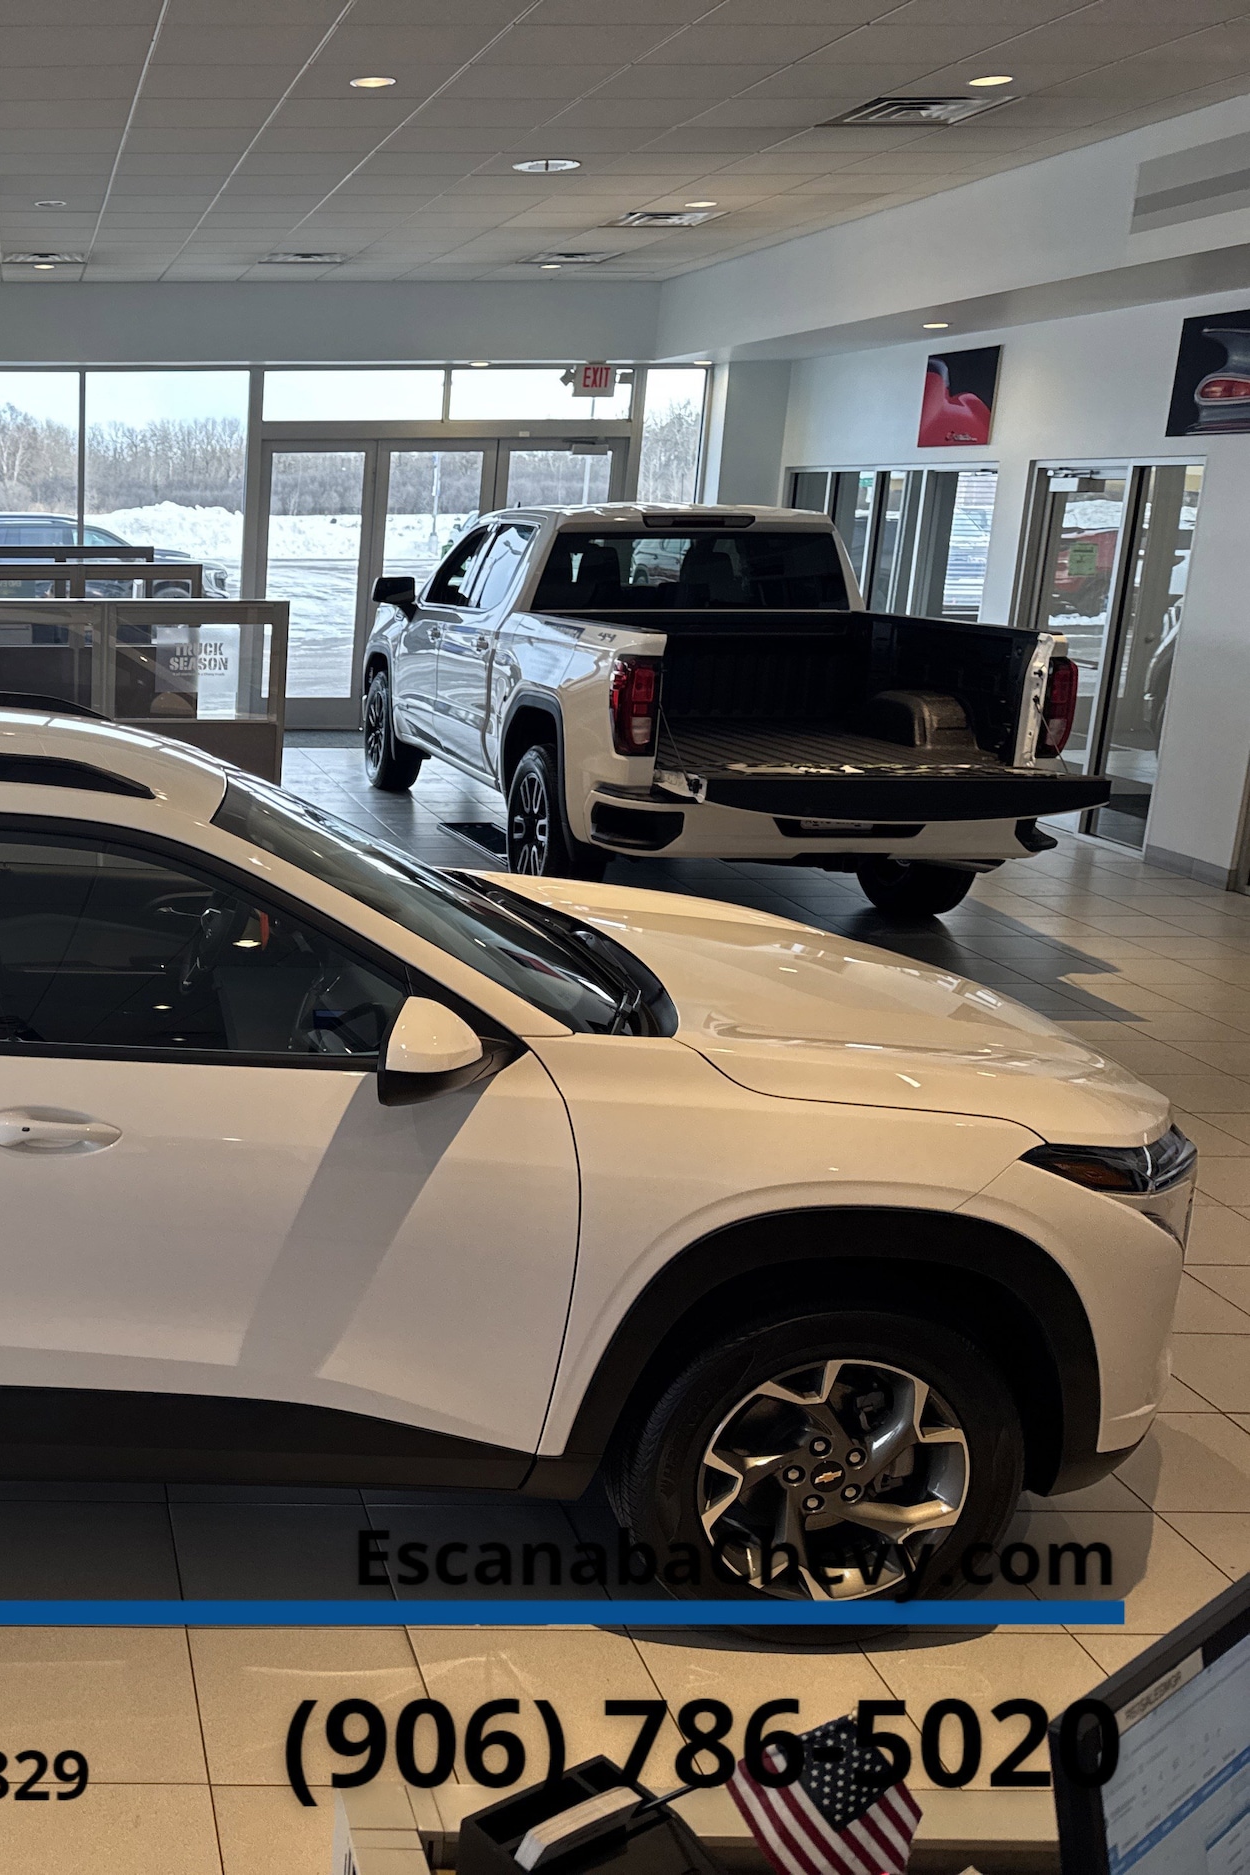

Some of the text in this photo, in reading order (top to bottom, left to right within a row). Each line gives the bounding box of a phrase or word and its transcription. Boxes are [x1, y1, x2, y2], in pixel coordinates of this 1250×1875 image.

[582, 366, 611, 388] EXIT
[174, 642, 225, 656] TRUCK
[168, 656, 229, 671] SEASON
